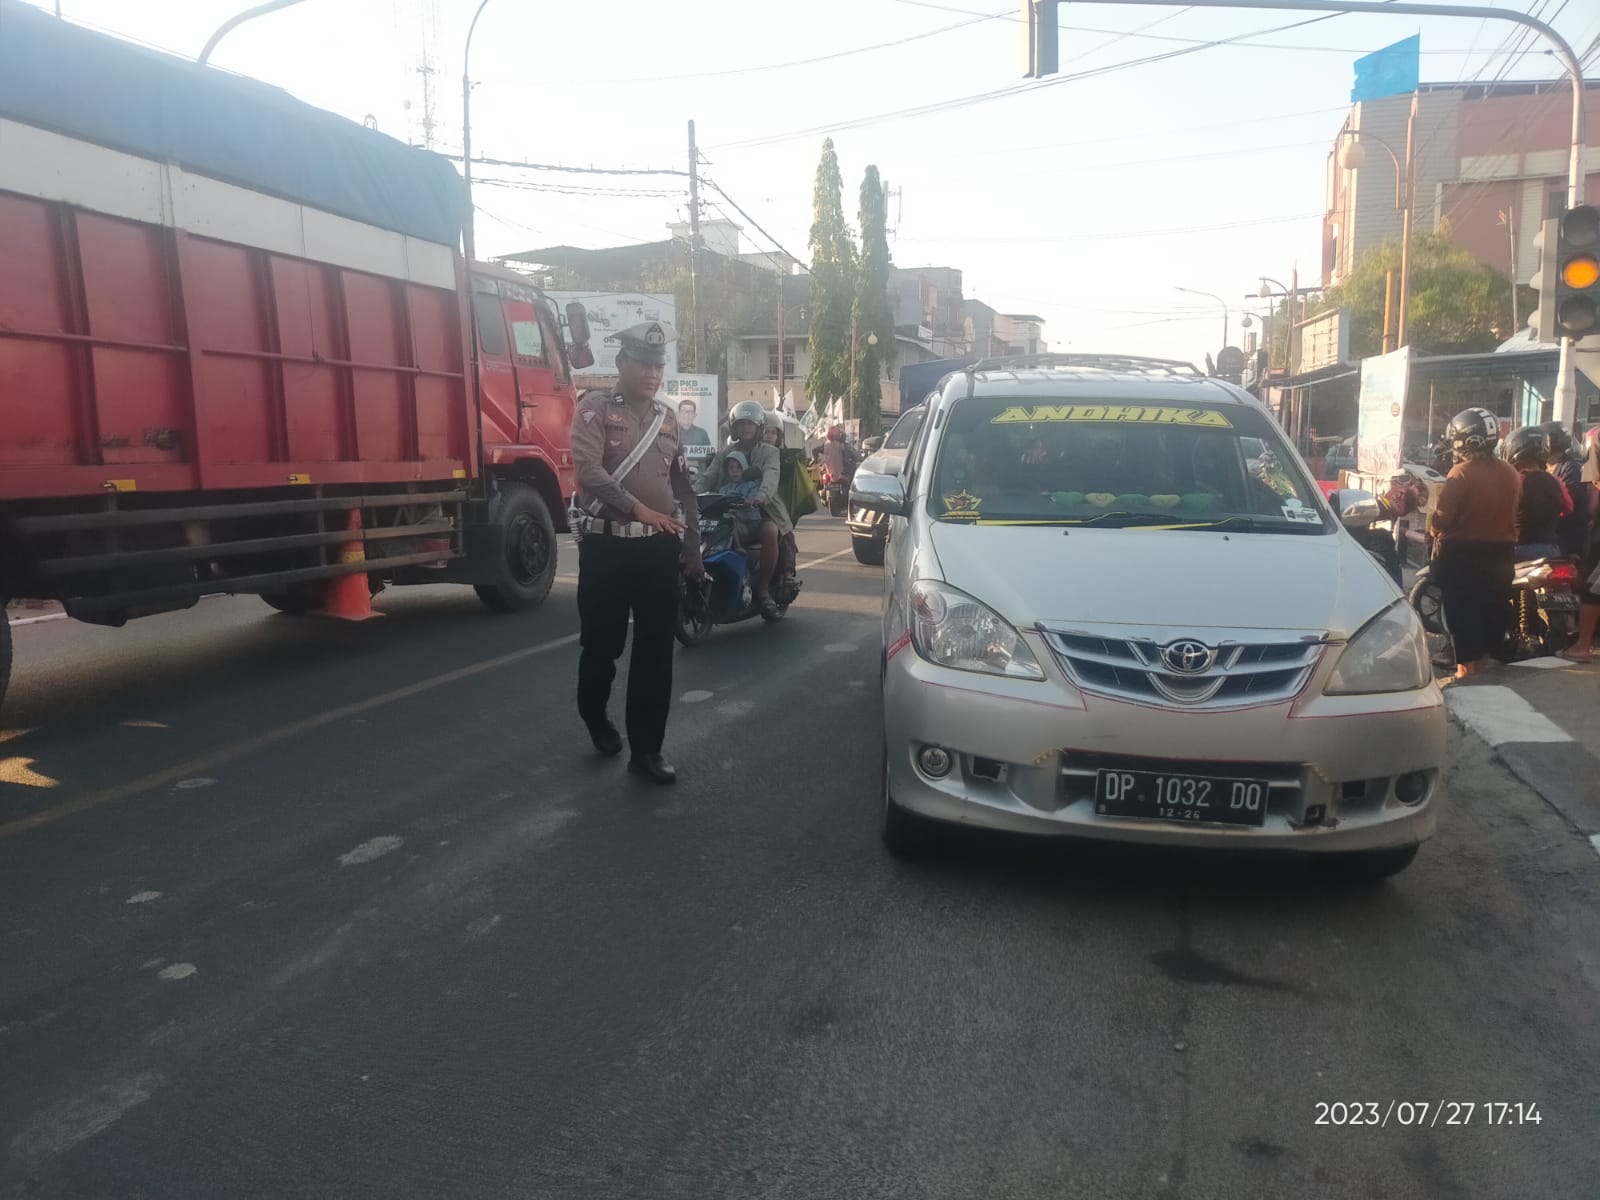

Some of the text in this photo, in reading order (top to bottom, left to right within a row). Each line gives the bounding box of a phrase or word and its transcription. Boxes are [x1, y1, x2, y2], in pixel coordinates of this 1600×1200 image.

[990, 405, 1234, 429] ANDHIKA
[1105, 772, 1262, 811] DP 1032 DQ
